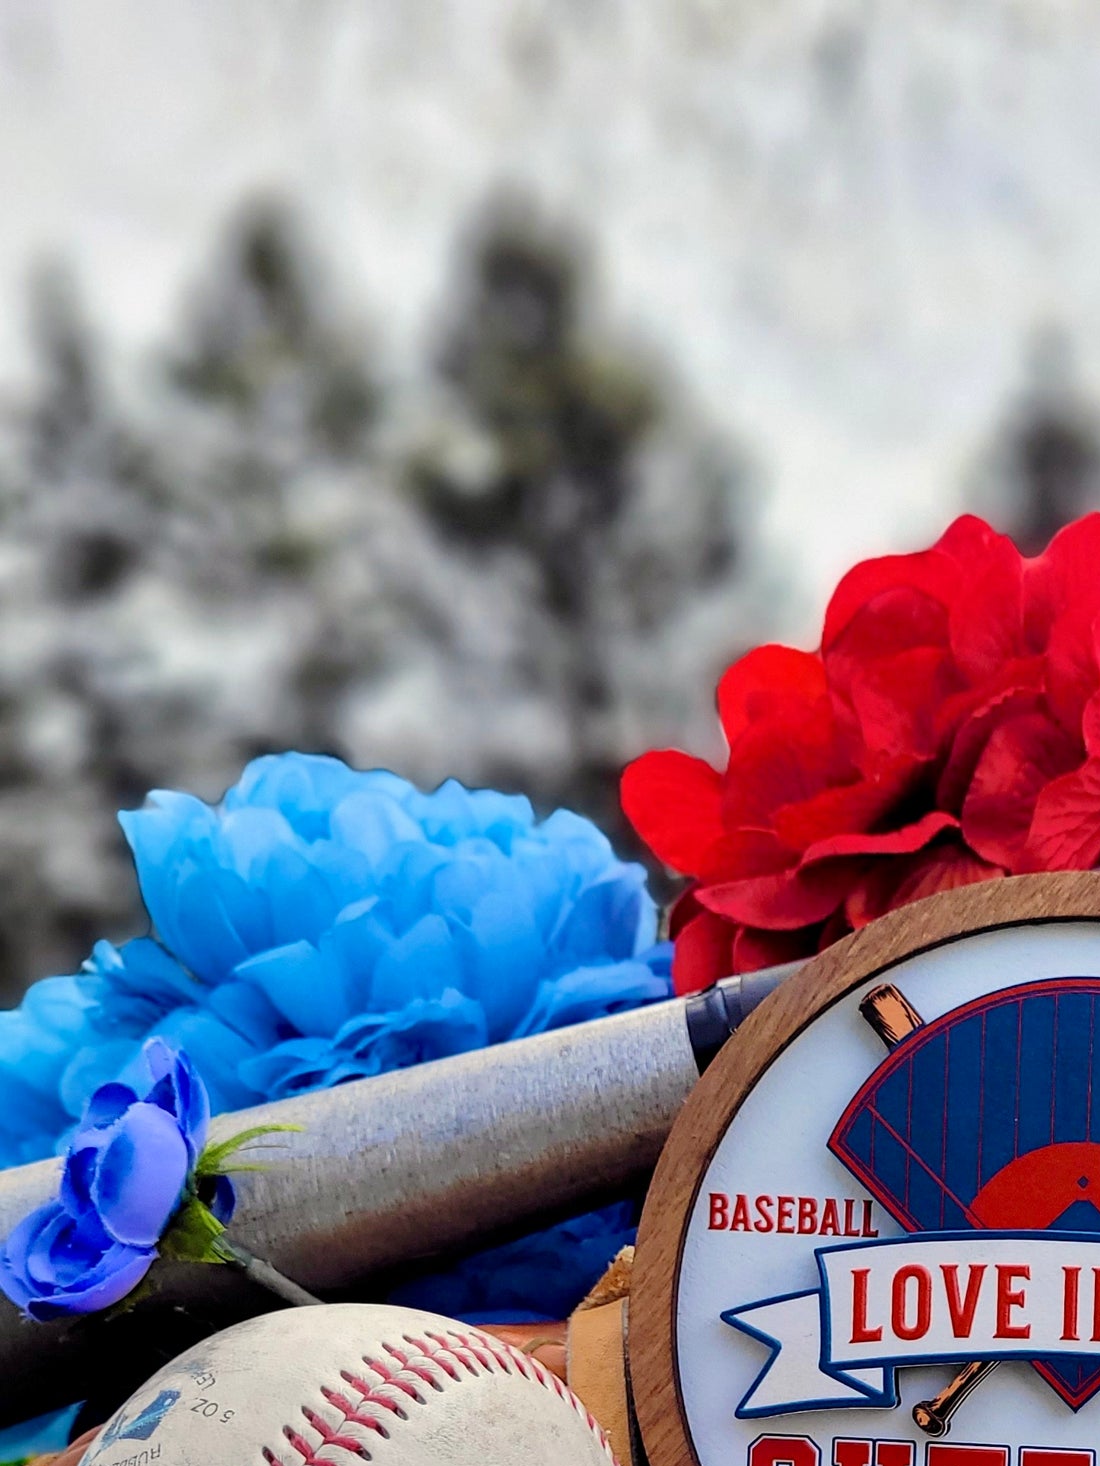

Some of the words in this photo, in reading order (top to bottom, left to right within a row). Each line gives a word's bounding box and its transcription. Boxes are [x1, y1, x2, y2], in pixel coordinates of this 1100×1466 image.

[707, 1192, 879, 1238] BASEBALL
[849, 1264, 1032, 1344] LOVE
[219, 1409, 236, 1424] 5
